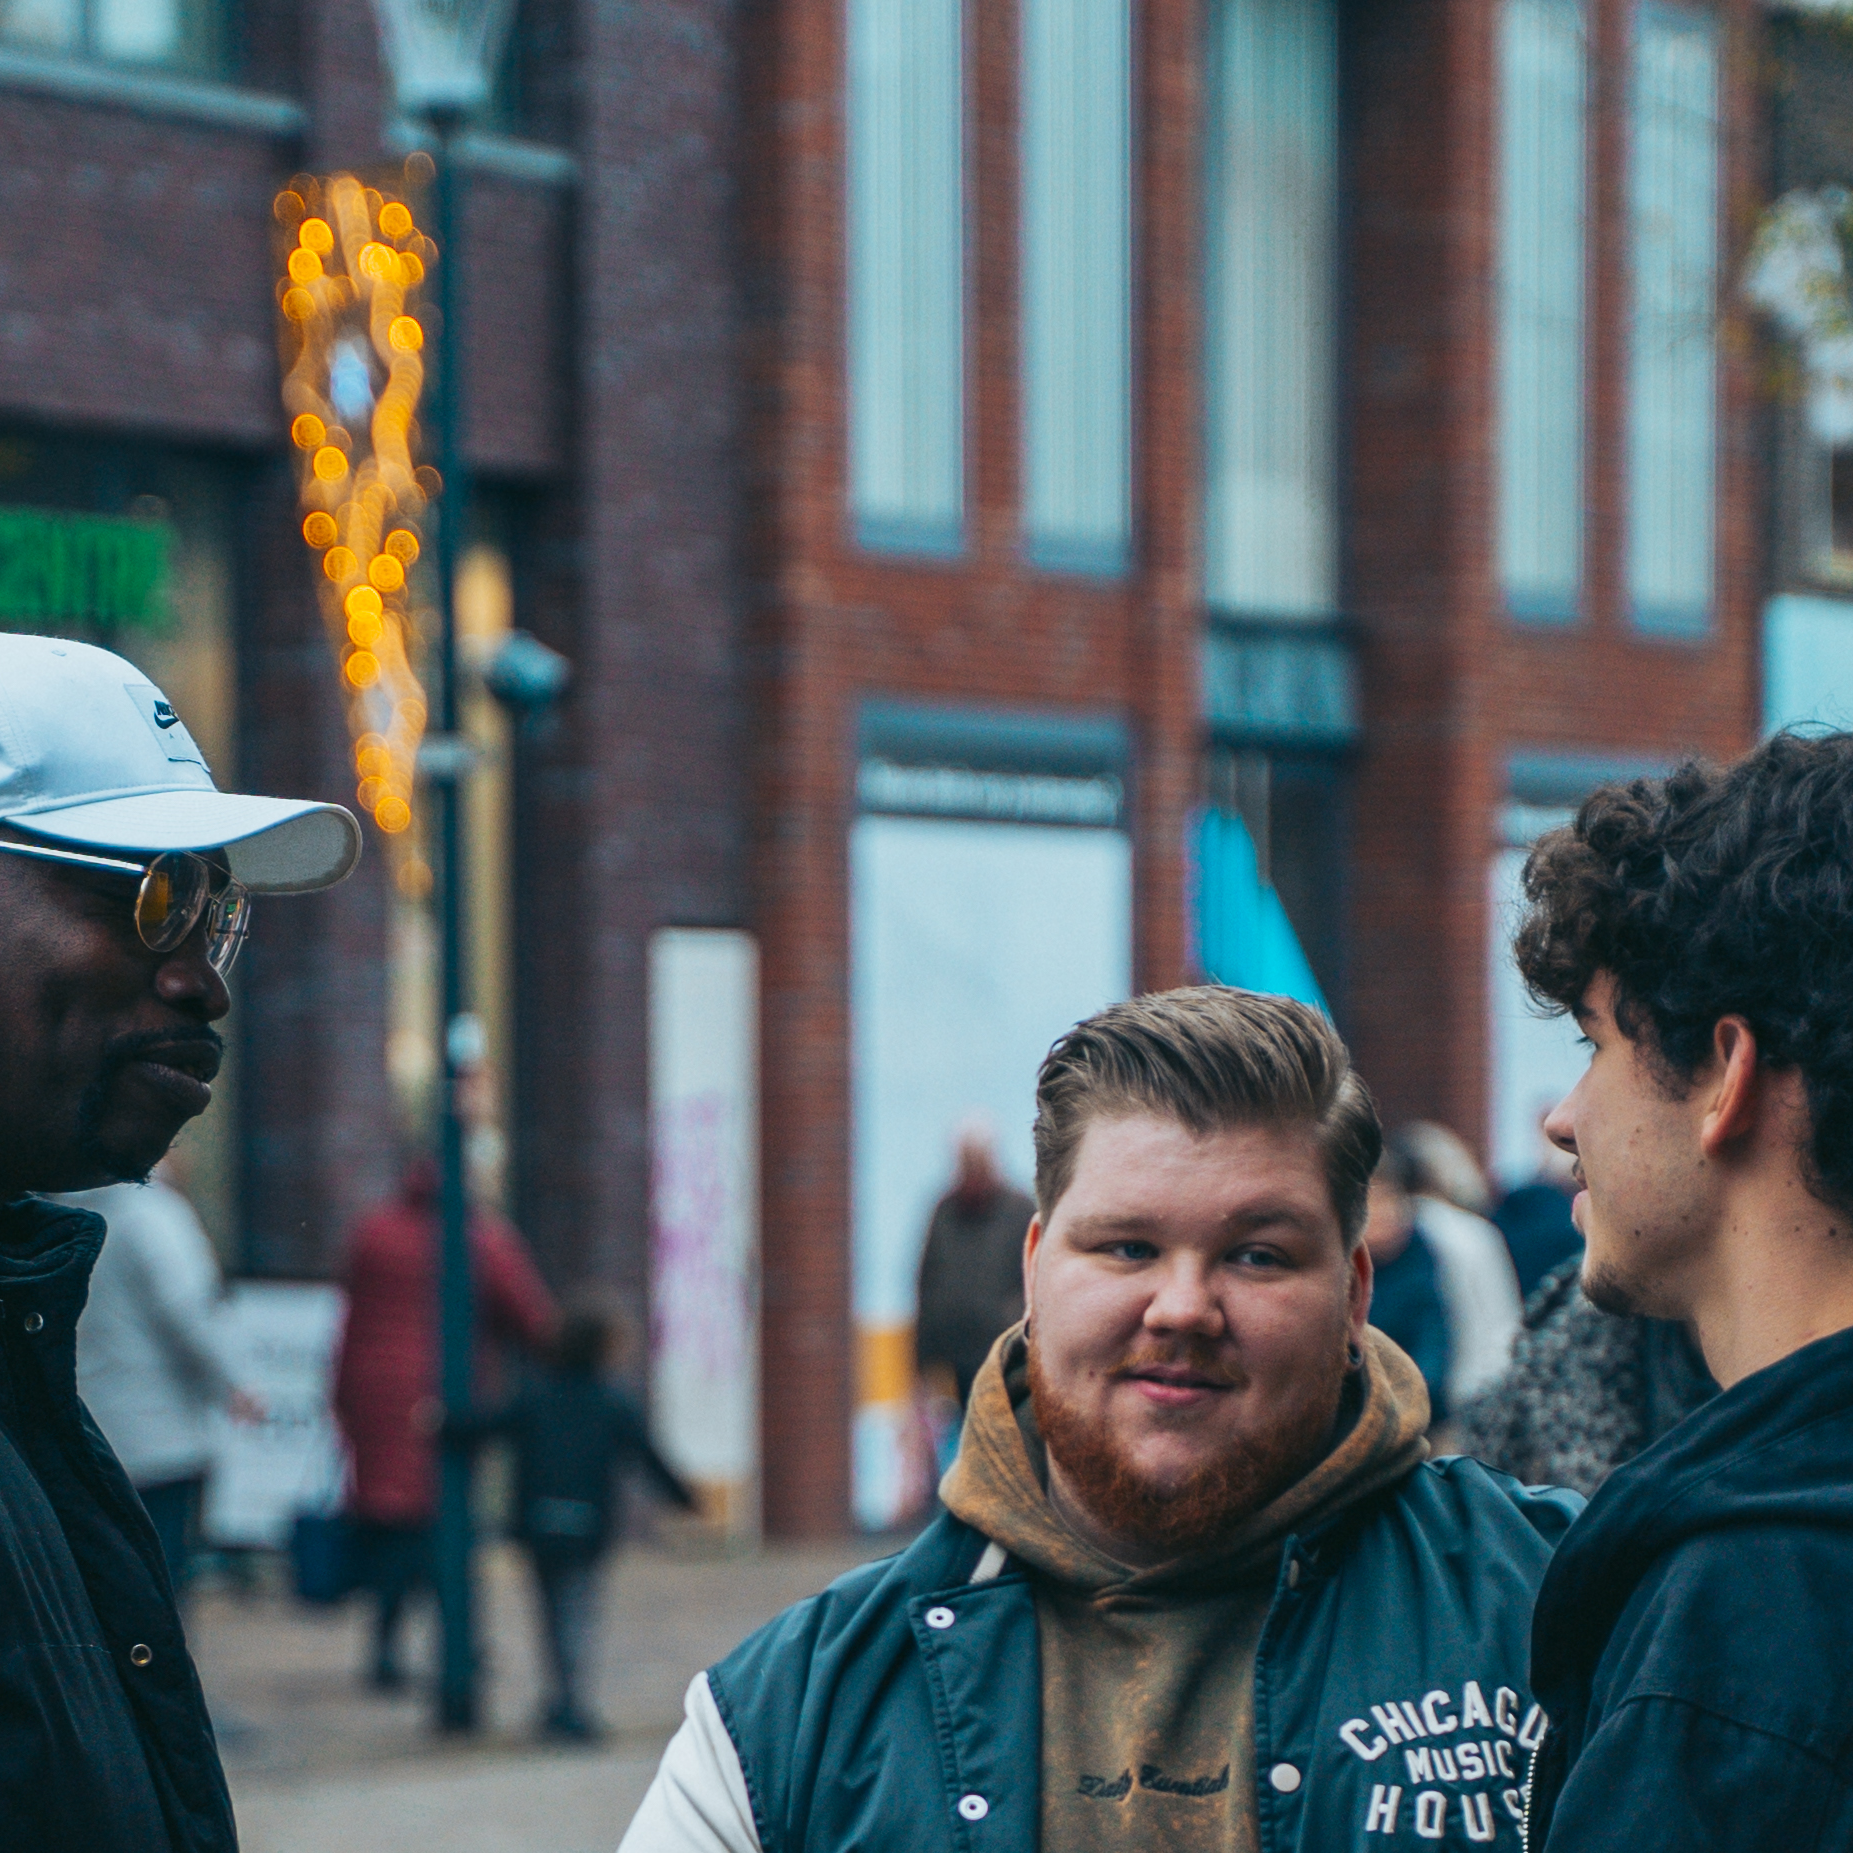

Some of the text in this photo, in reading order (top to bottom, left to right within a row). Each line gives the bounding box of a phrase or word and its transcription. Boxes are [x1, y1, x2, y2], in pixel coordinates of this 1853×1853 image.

[1338, 1680, 1549, 1761] CHICAGO
[1404, 1739, 1517, 1785] MUSIC
[1364, 1783, 1532, 1842] HOUS
